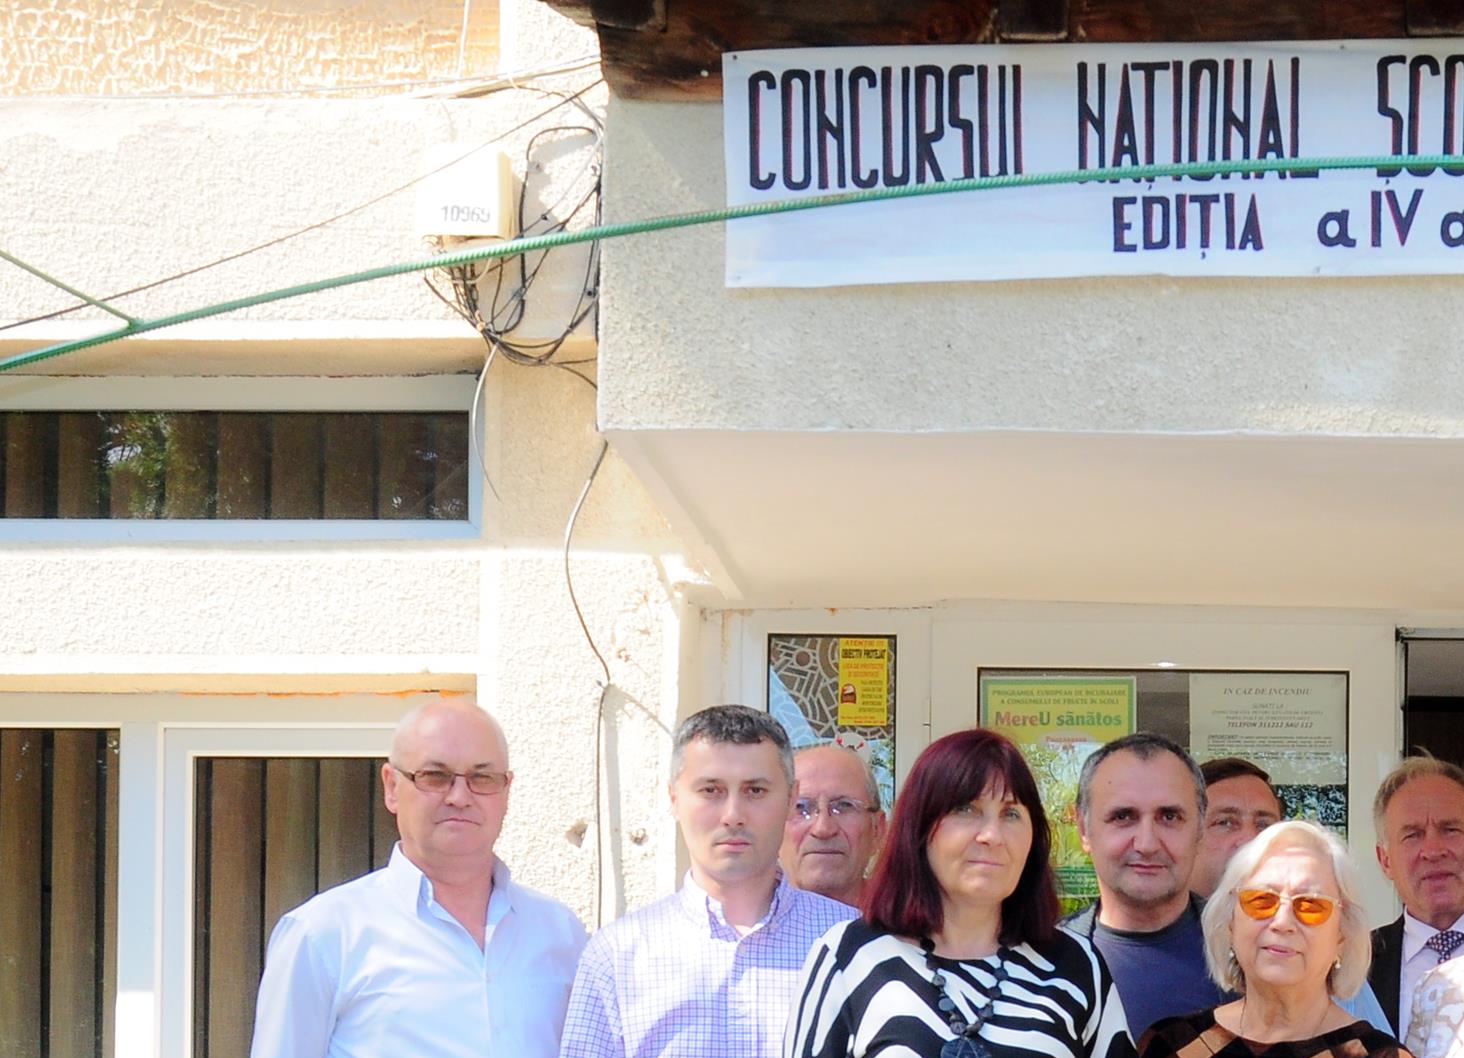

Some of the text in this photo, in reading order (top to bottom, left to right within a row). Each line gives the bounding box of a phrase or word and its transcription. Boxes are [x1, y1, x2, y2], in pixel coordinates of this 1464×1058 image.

[746, 62, 1025, 192] CONCURSUL
[1369, 188, 1424, 249] IV
[994, 711, 1050, 727] MereU
